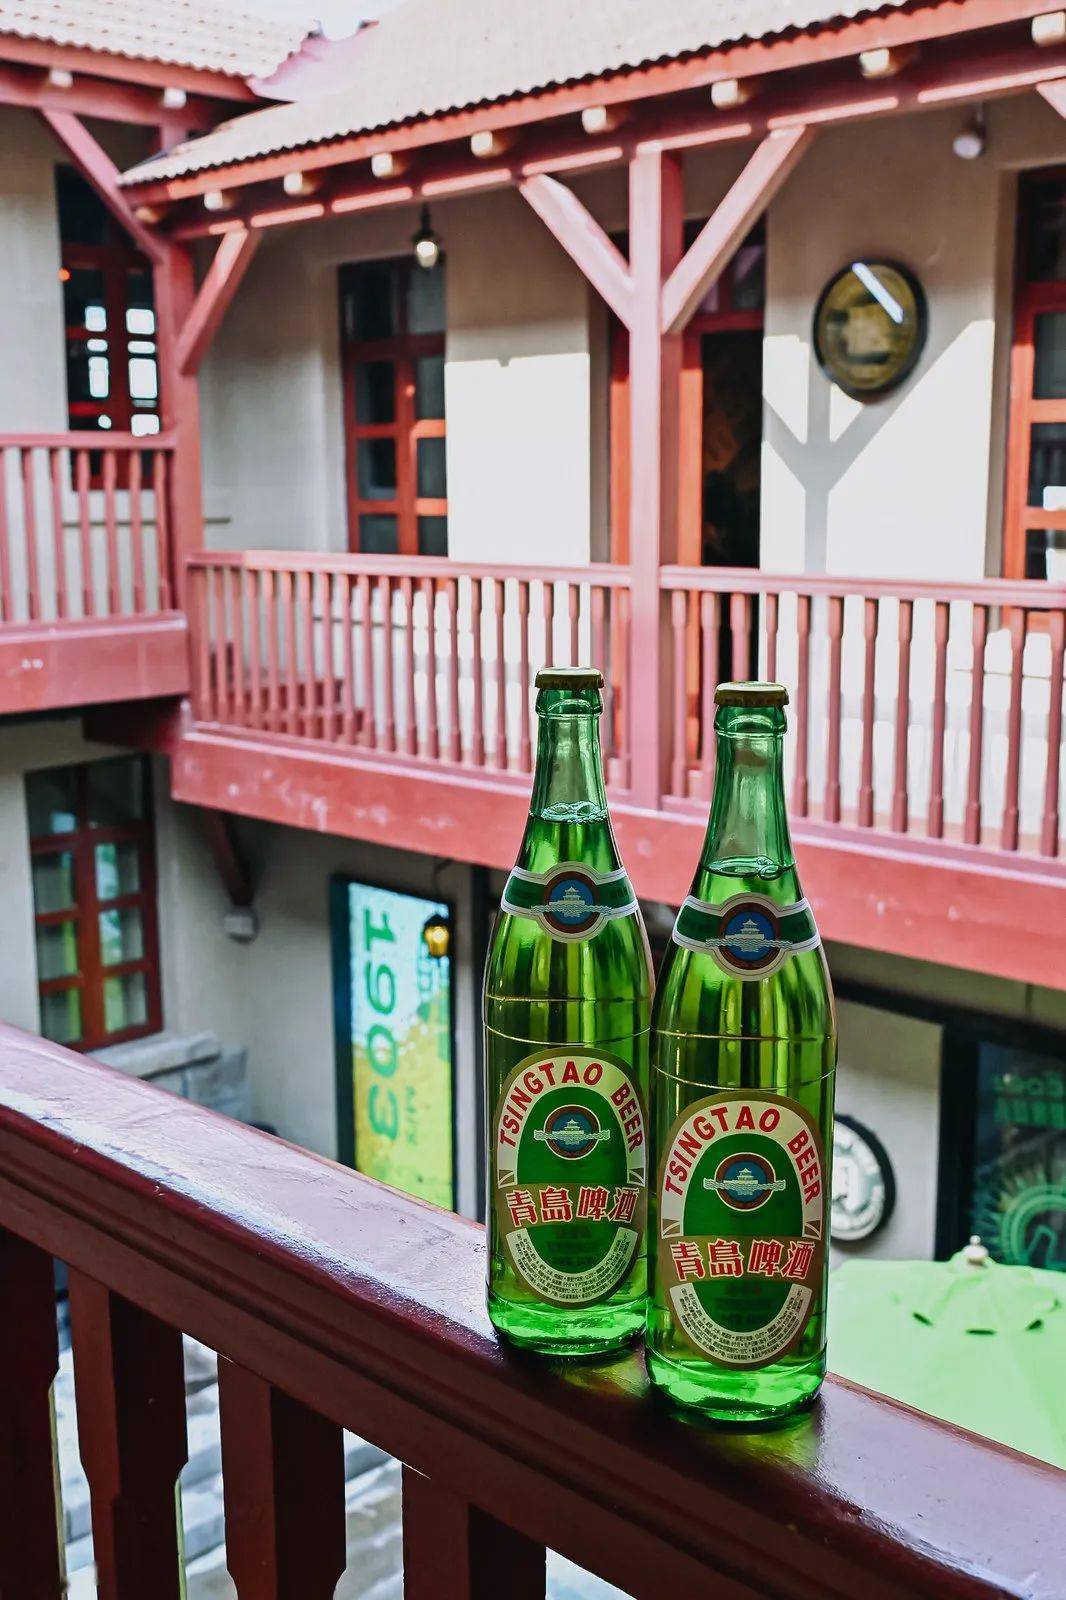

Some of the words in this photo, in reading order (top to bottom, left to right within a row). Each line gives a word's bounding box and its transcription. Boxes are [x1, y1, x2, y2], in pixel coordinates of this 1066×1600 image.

[363, 905, 399, 1141] 1903
[499, 1060, 604, 1148] TSINGTAO
[610, 1082, 644, 1153] BEER
[664, 1105, 780, 1196] TSINGTAO
[787, 1129, 821, 1205] BEER
[505, 1185, 640, 1228] 青島啤酒
[669, 1238, 815, 1282] 青島啤酒
